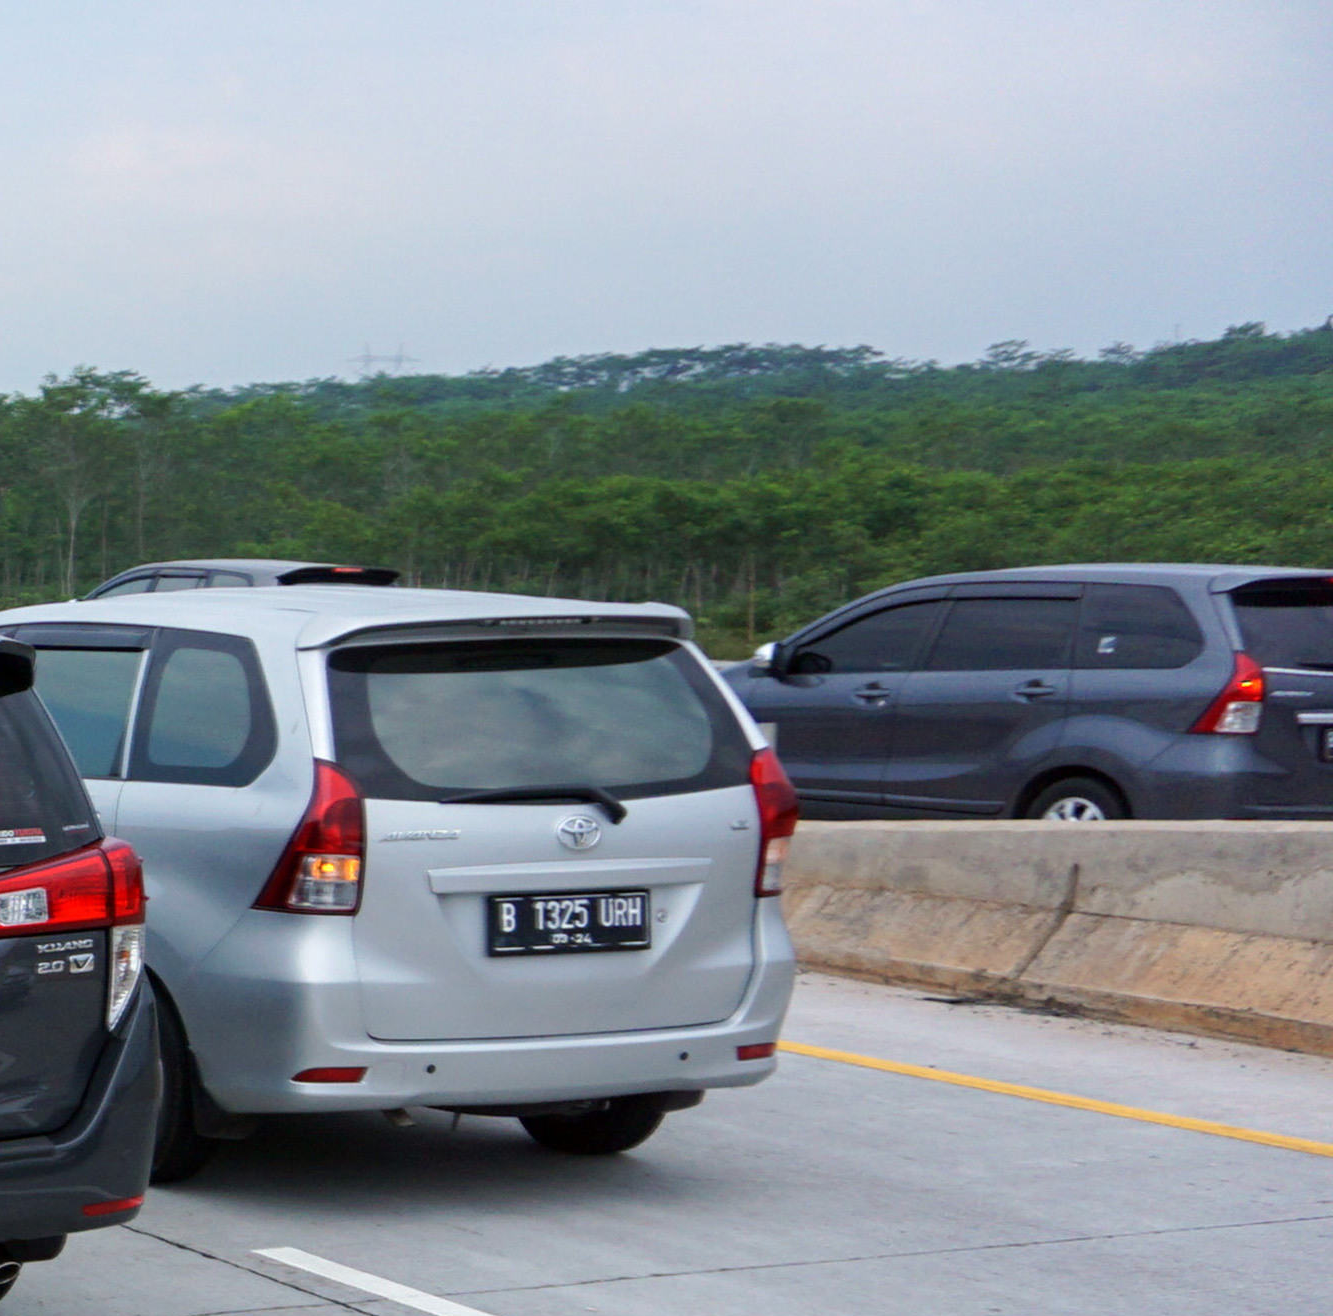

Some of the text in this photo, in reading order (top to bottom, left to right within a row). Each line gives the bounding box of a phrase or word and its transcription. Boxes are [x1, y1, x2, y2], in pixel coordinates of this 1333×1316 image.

[501, 897, 642, 933] B 1325 URH
